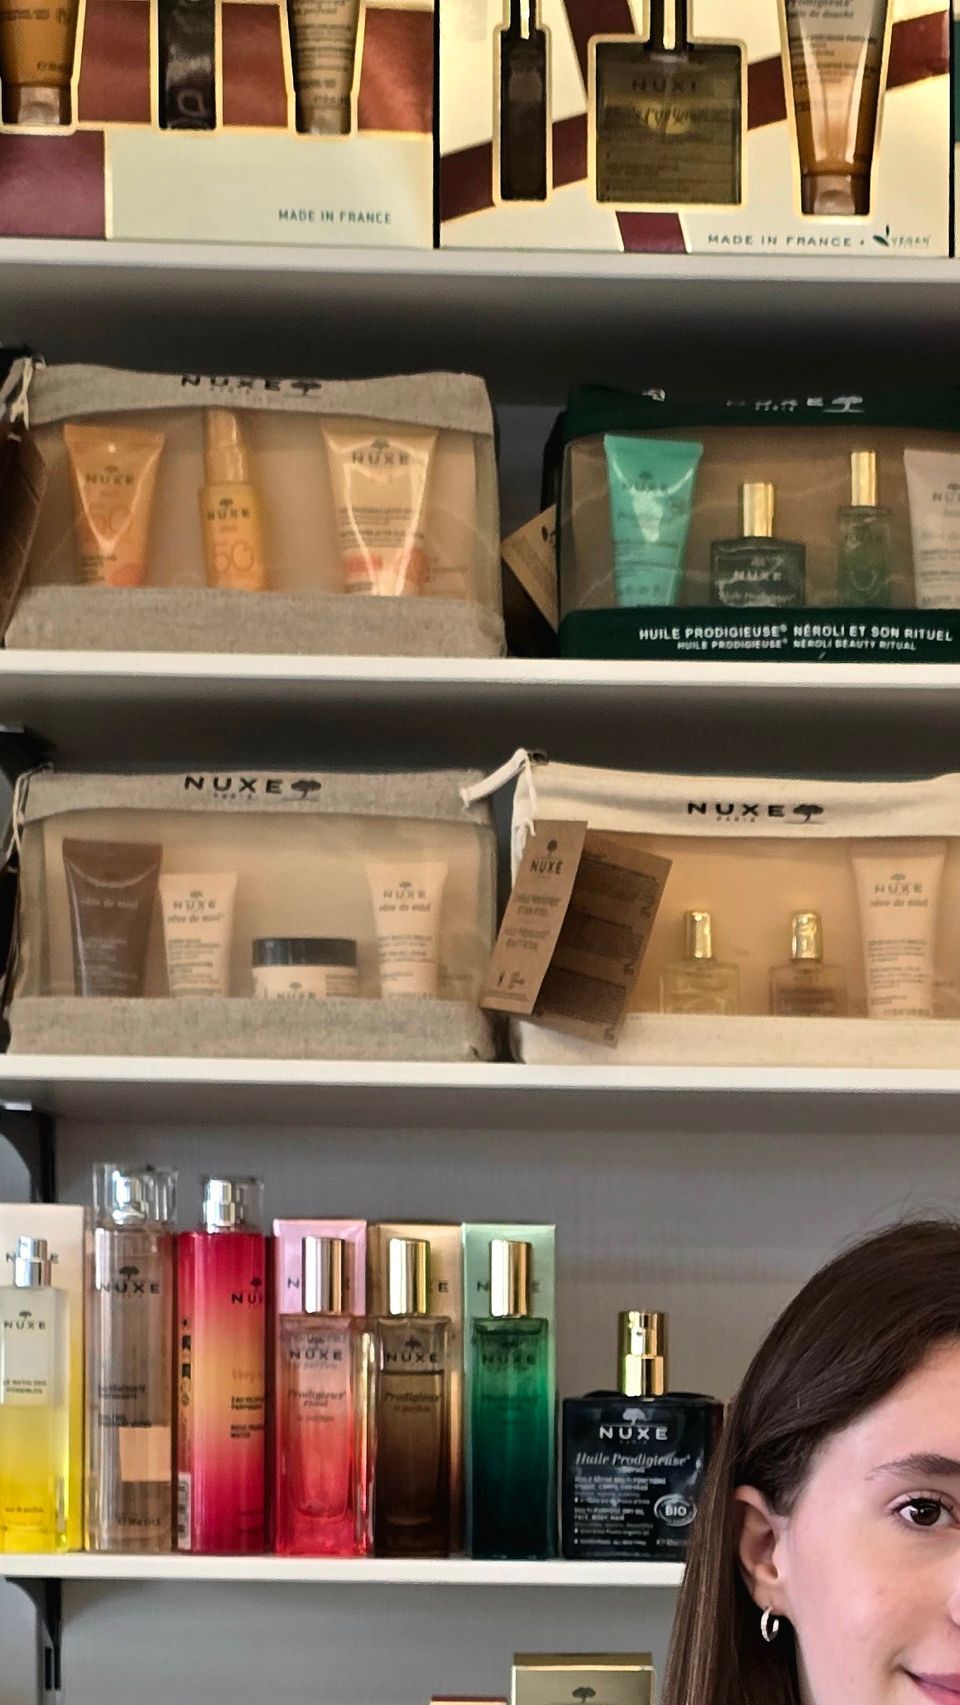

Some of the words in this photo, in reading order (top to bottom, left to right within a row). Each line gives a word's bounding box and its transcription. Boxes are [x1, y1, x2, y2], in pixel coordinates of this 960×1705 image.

[279, 209, 315, 222] MADE
[320, 210, 334, 222] IN
[339, 211, 392, 224] FRANCE
[707, 234, 754, 246] MADE
[760, 235, 779, 246] IN
[786, 235, 852, 248] FRANCE
[181, 375, 281, 391] NUXE
[639, 627, 681, 640] HUILE
[793, 623, 846, 637] NÉROLI
[849, 625, 867, 637] ET
[871, 626, 900, 639] SON
[904, 627, 953, 641] RITUEL
[185, 776, 284, 794] NUXE
[688, 801, 786, 818] NUXE
[530, 860, 563, 875] NUXE
[101, 1282, 160, 1294] NUXE
[4, 1321, 46, 1330] NUXE
[385, 1353, 438, 1363] NUXE
[600, 1426, 668, 1440] NUXE
[575, 1452, 610, 1466] Huile
[665, 1504, 688, 1517] BIO
